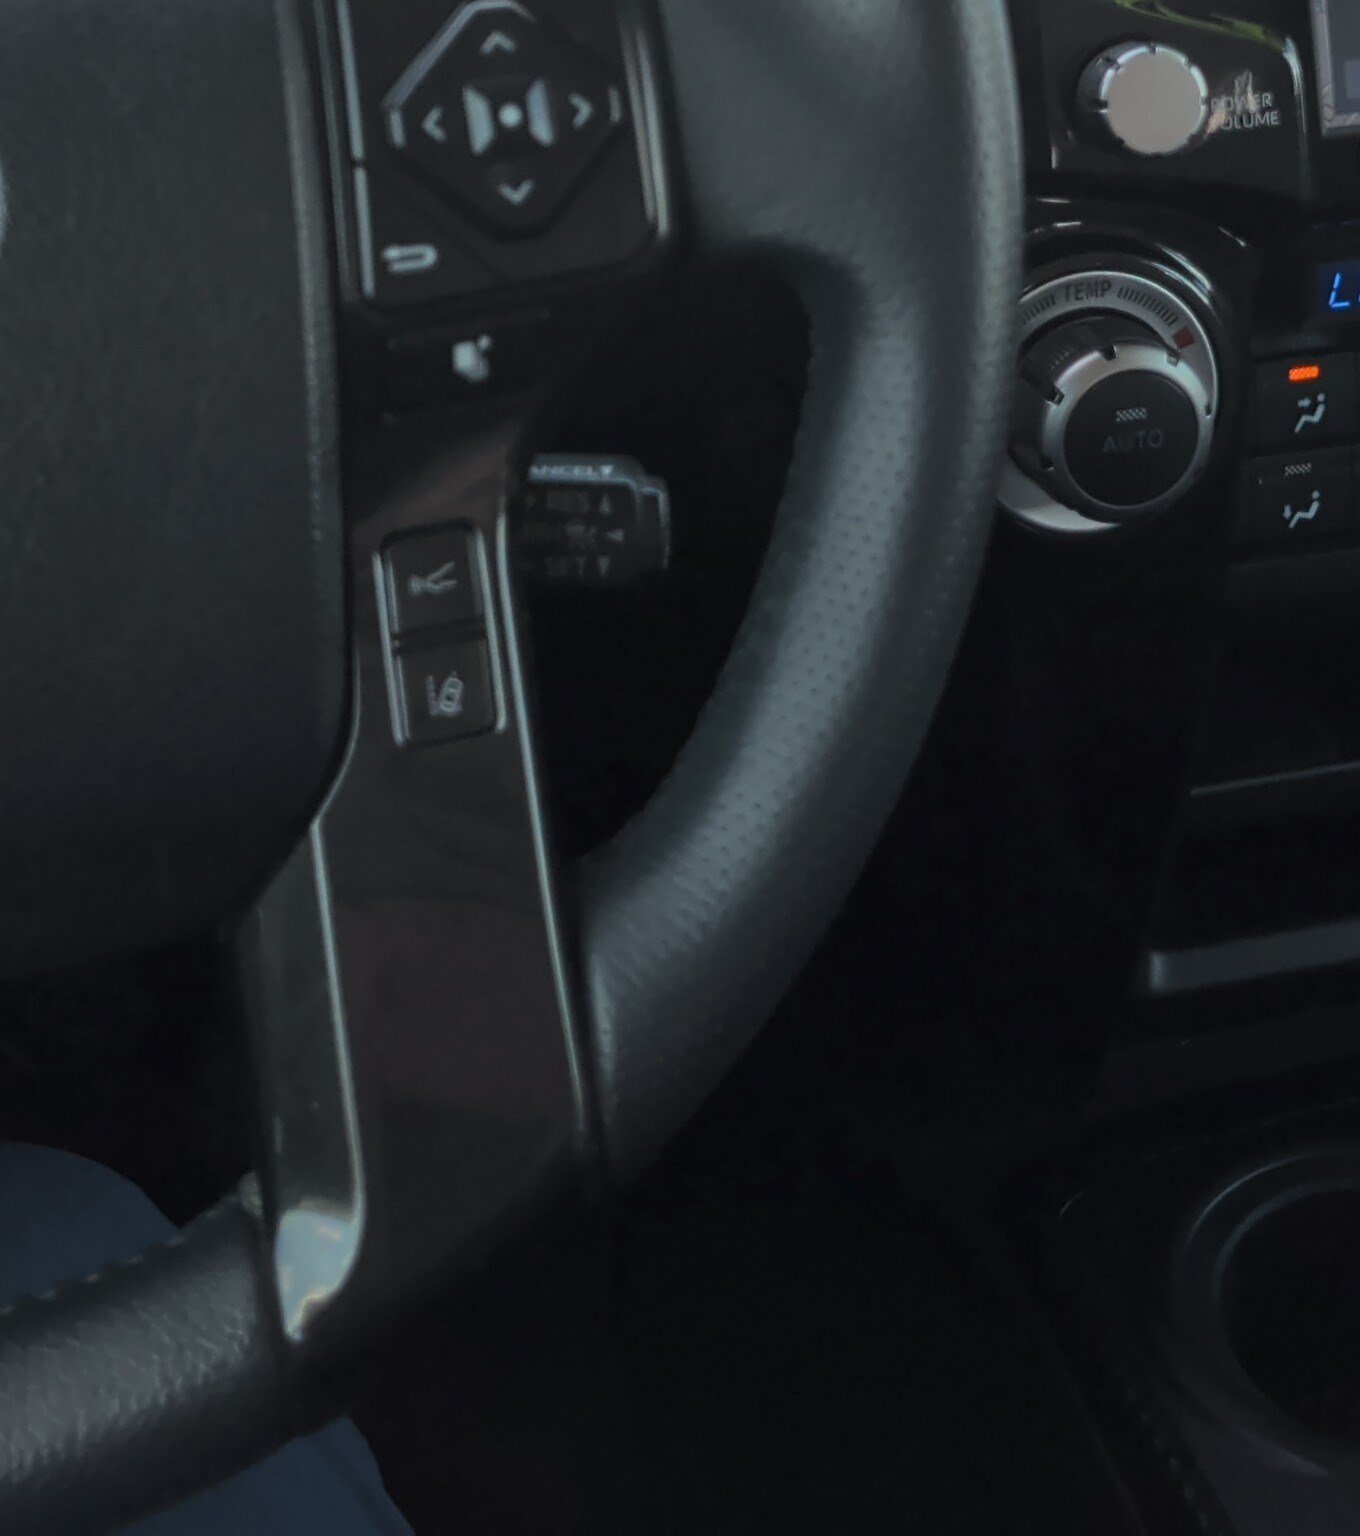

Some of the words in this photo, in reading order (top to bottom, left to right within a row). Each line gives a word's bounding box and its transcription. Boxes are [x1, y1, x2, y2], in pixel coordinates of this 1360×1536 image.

[1210, 91, 1273, 114] POWER
[1211, 110, 1281, 132] OLUME
[1063, 279, 1112, 302] TEMP
[1103, 428, 1164, 453] AUTO
